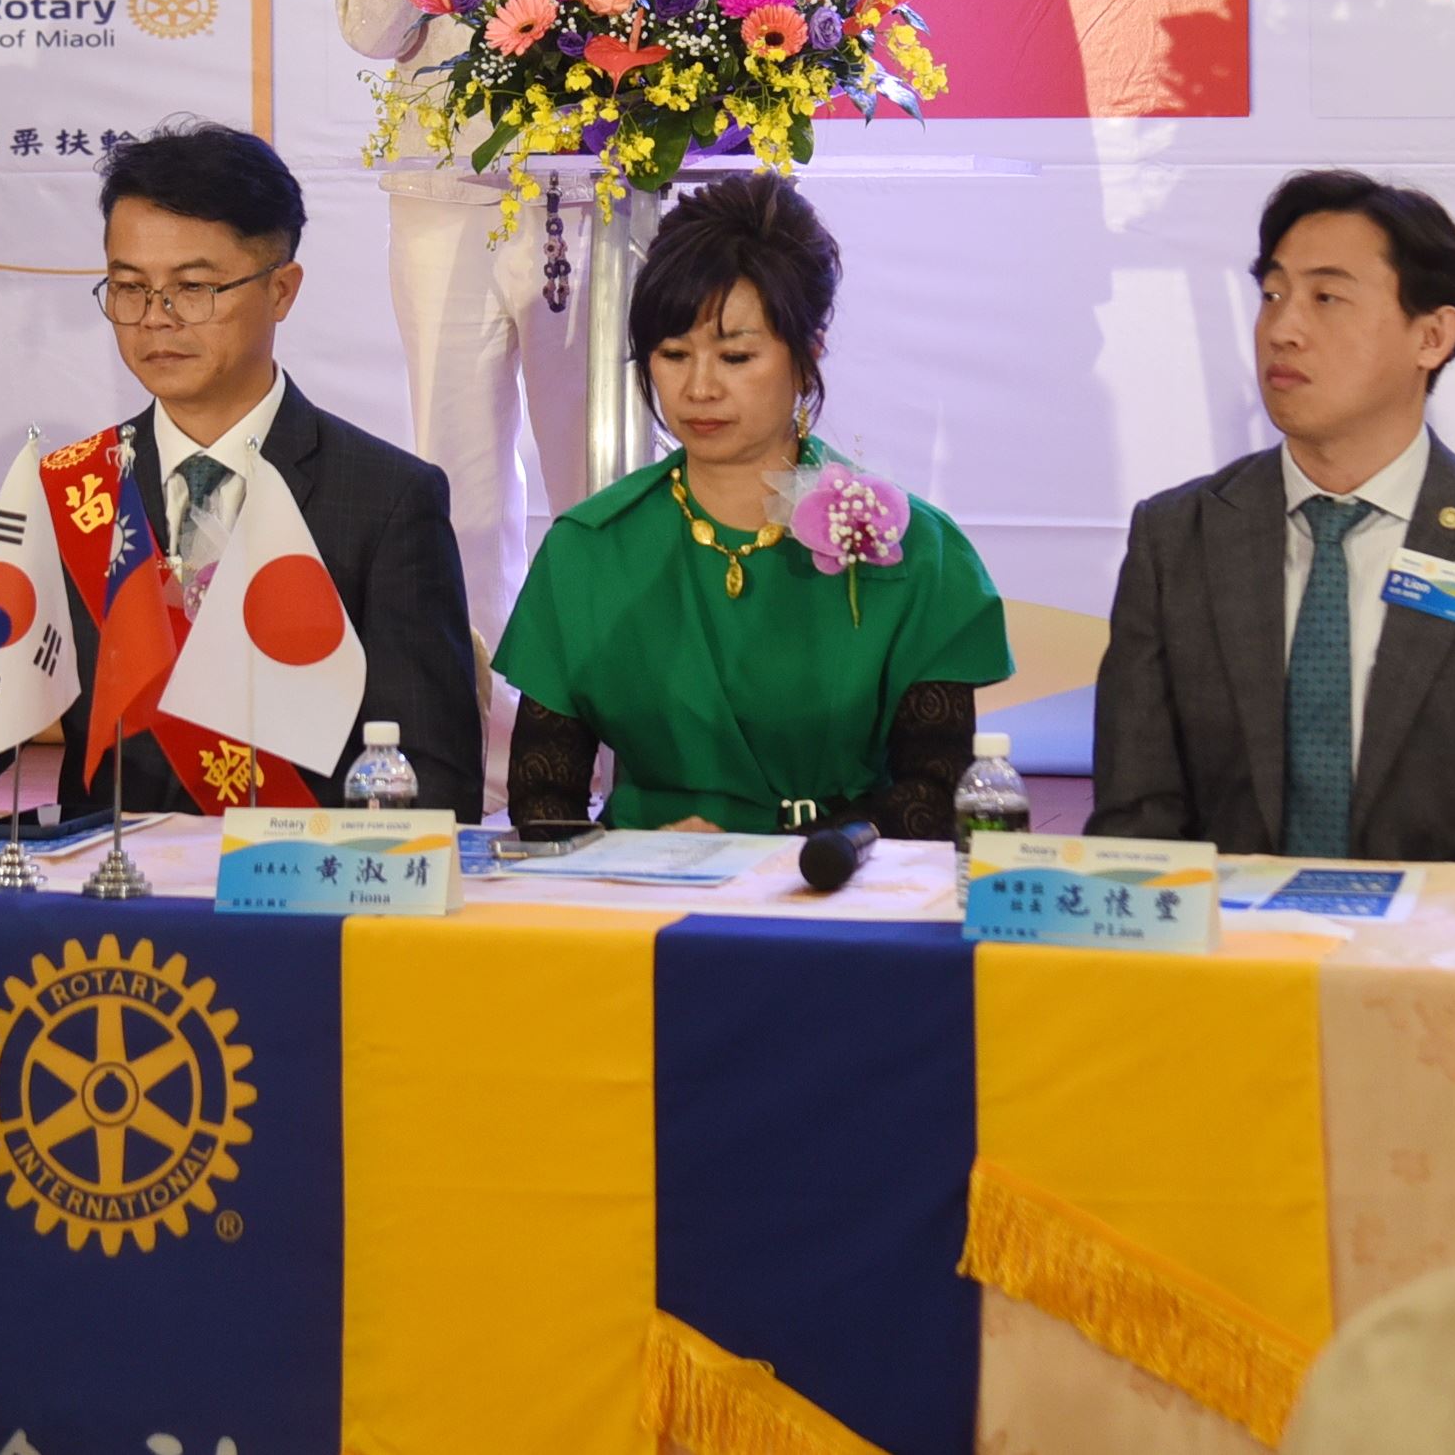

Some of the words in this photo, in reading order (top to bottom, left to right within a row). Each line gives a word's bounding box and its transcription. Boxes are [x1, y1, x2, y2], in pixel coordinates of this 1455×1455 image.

[35, 28, 116, 49] Miaoli
[65, 473, 114, 534] 苗
[269, 816, 307, 831] Rotary
[348, 890, 392, 905] Fiona
[49, 969, 169, 1007] ROTARY
[12, 1141, 214, 1221] INTERNATIONAL
